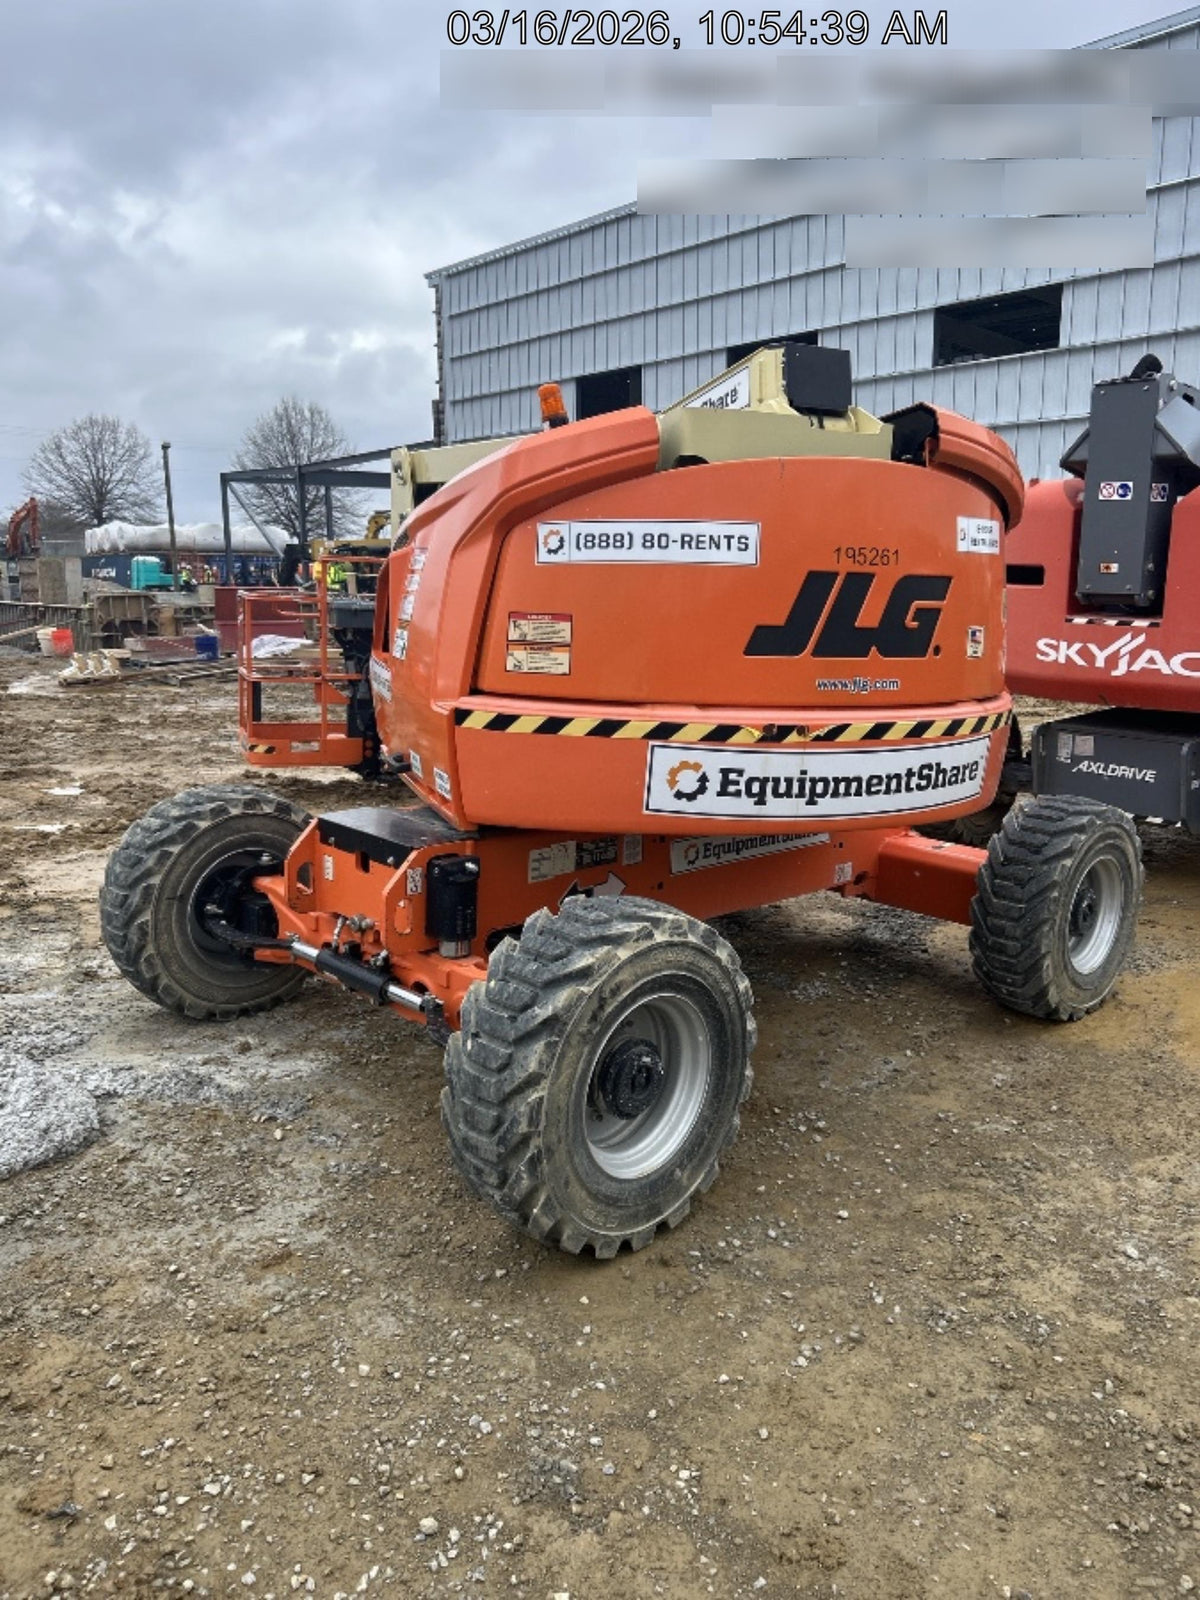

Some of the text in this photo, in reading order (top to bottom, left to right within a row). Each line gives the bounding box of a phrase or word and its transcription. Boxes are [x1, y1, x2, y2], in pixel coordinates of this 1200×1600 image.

[575, 532, 750, 552] (888) 80-RENTS
[833, 547, 900, 566] 195261
[742, 570, 953, 658] JLG
[816, 677, 901, 694] www.jlg.com
[1071, 760, 1158, 783] AXLDRIVE
[716, 759, 980, 807] EquipmentShare
